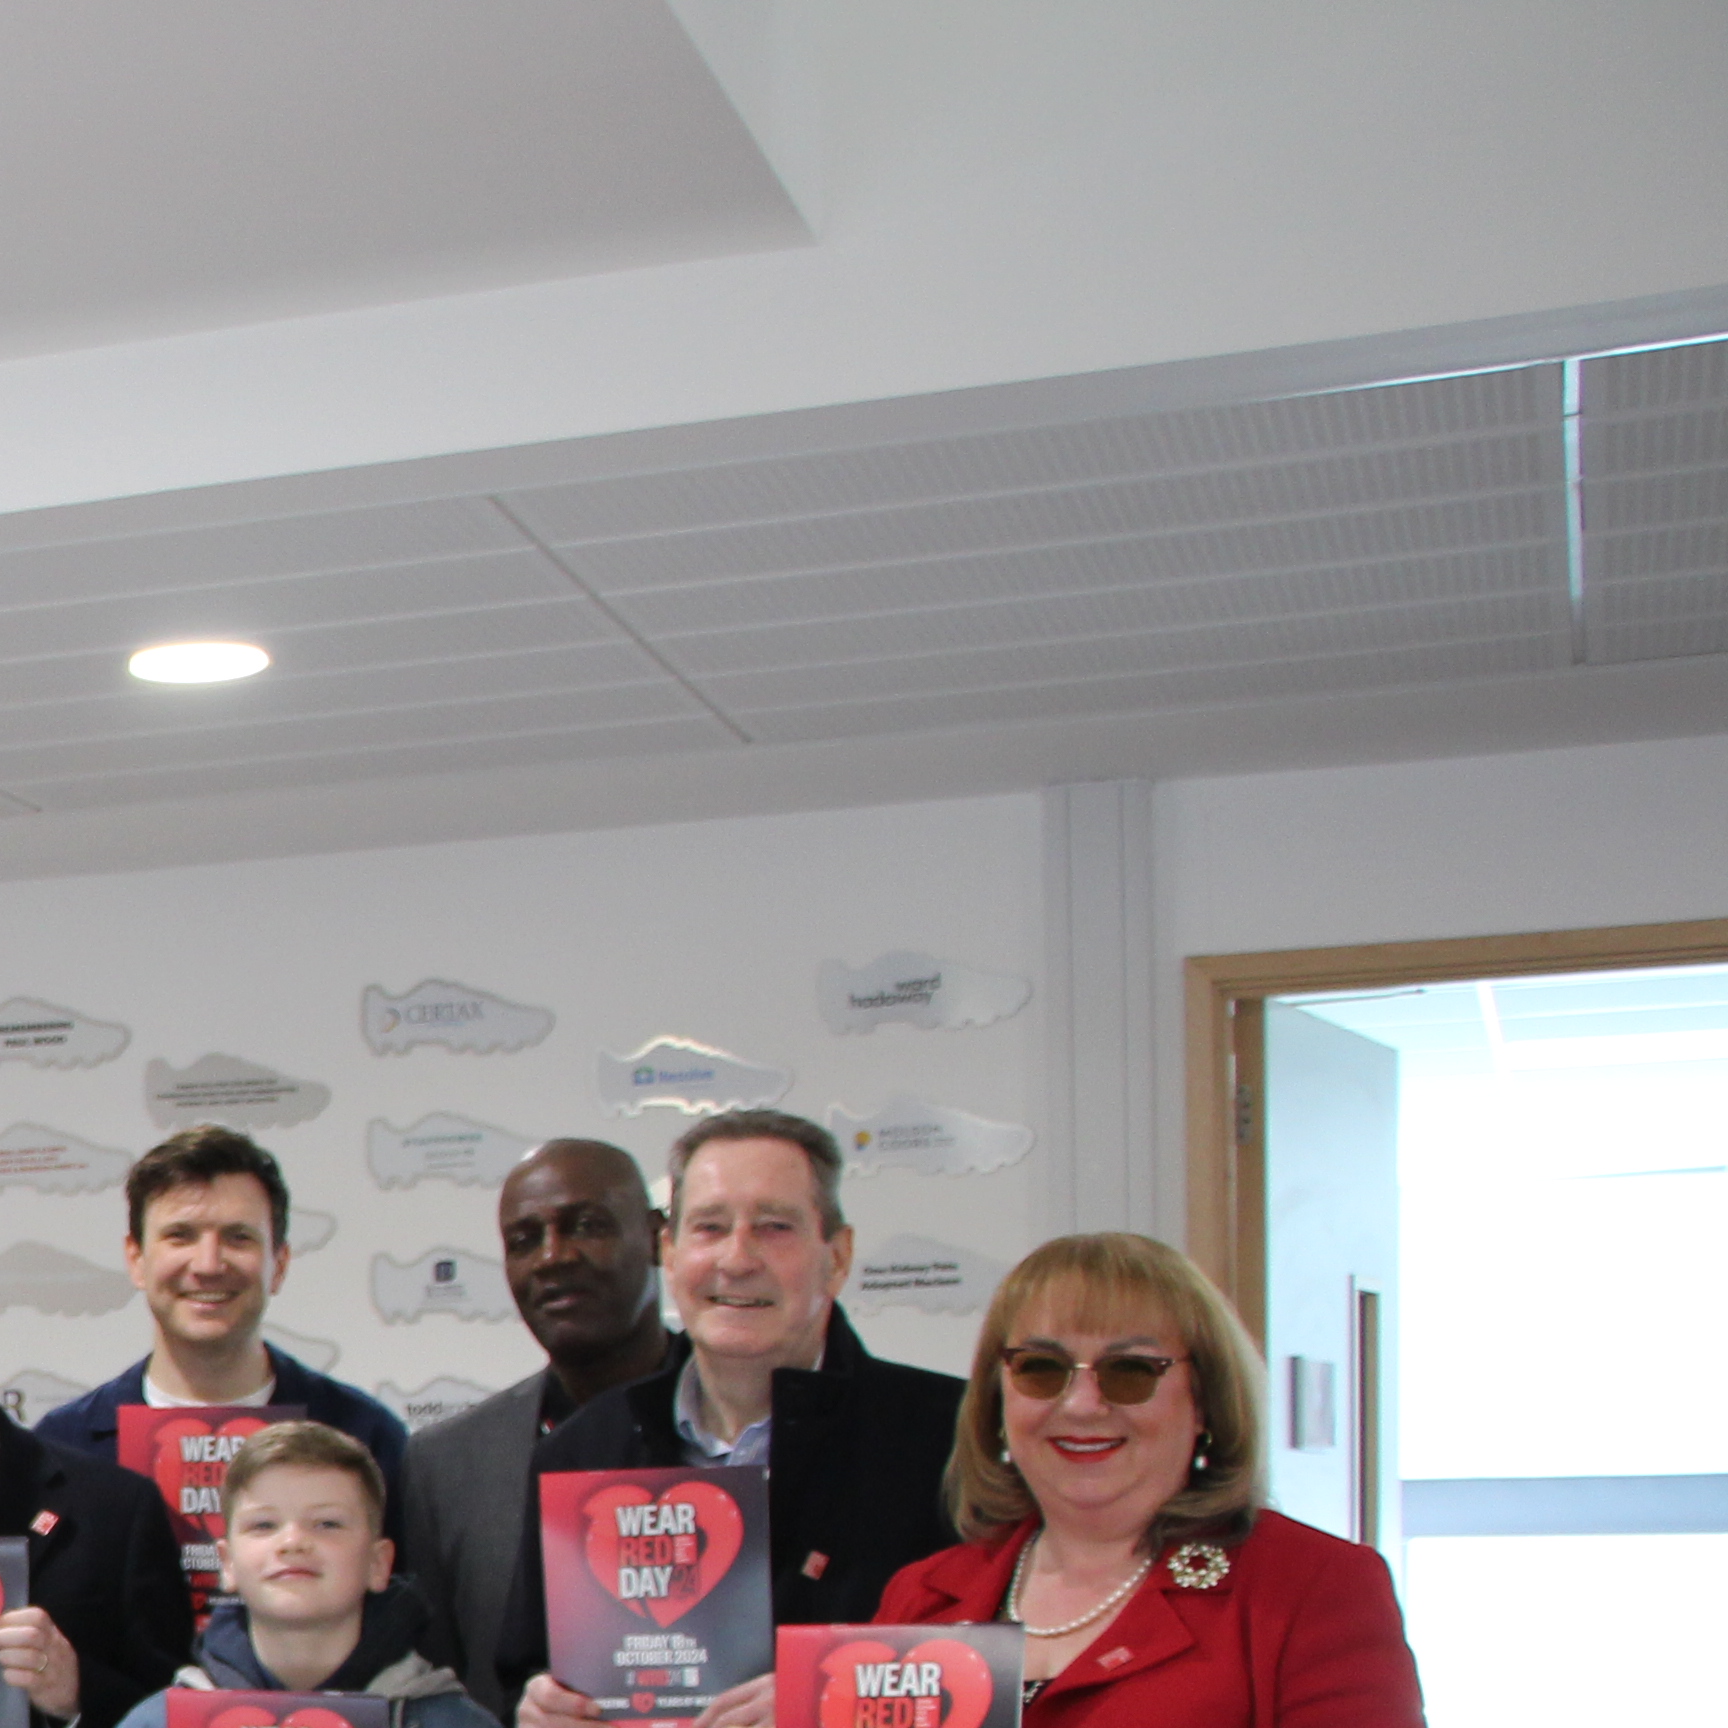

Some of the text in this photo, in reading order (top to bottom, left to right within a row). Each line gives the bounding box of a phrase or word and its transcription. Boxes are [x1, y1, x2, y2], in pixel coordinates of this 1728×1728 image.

[616, 1503, 696, 1537] WEAR
[620, 1537, 673, 1566] RED
[619, 1566, 673, 1598] DAY
[855, 1662, 941, 1698] WEAR
